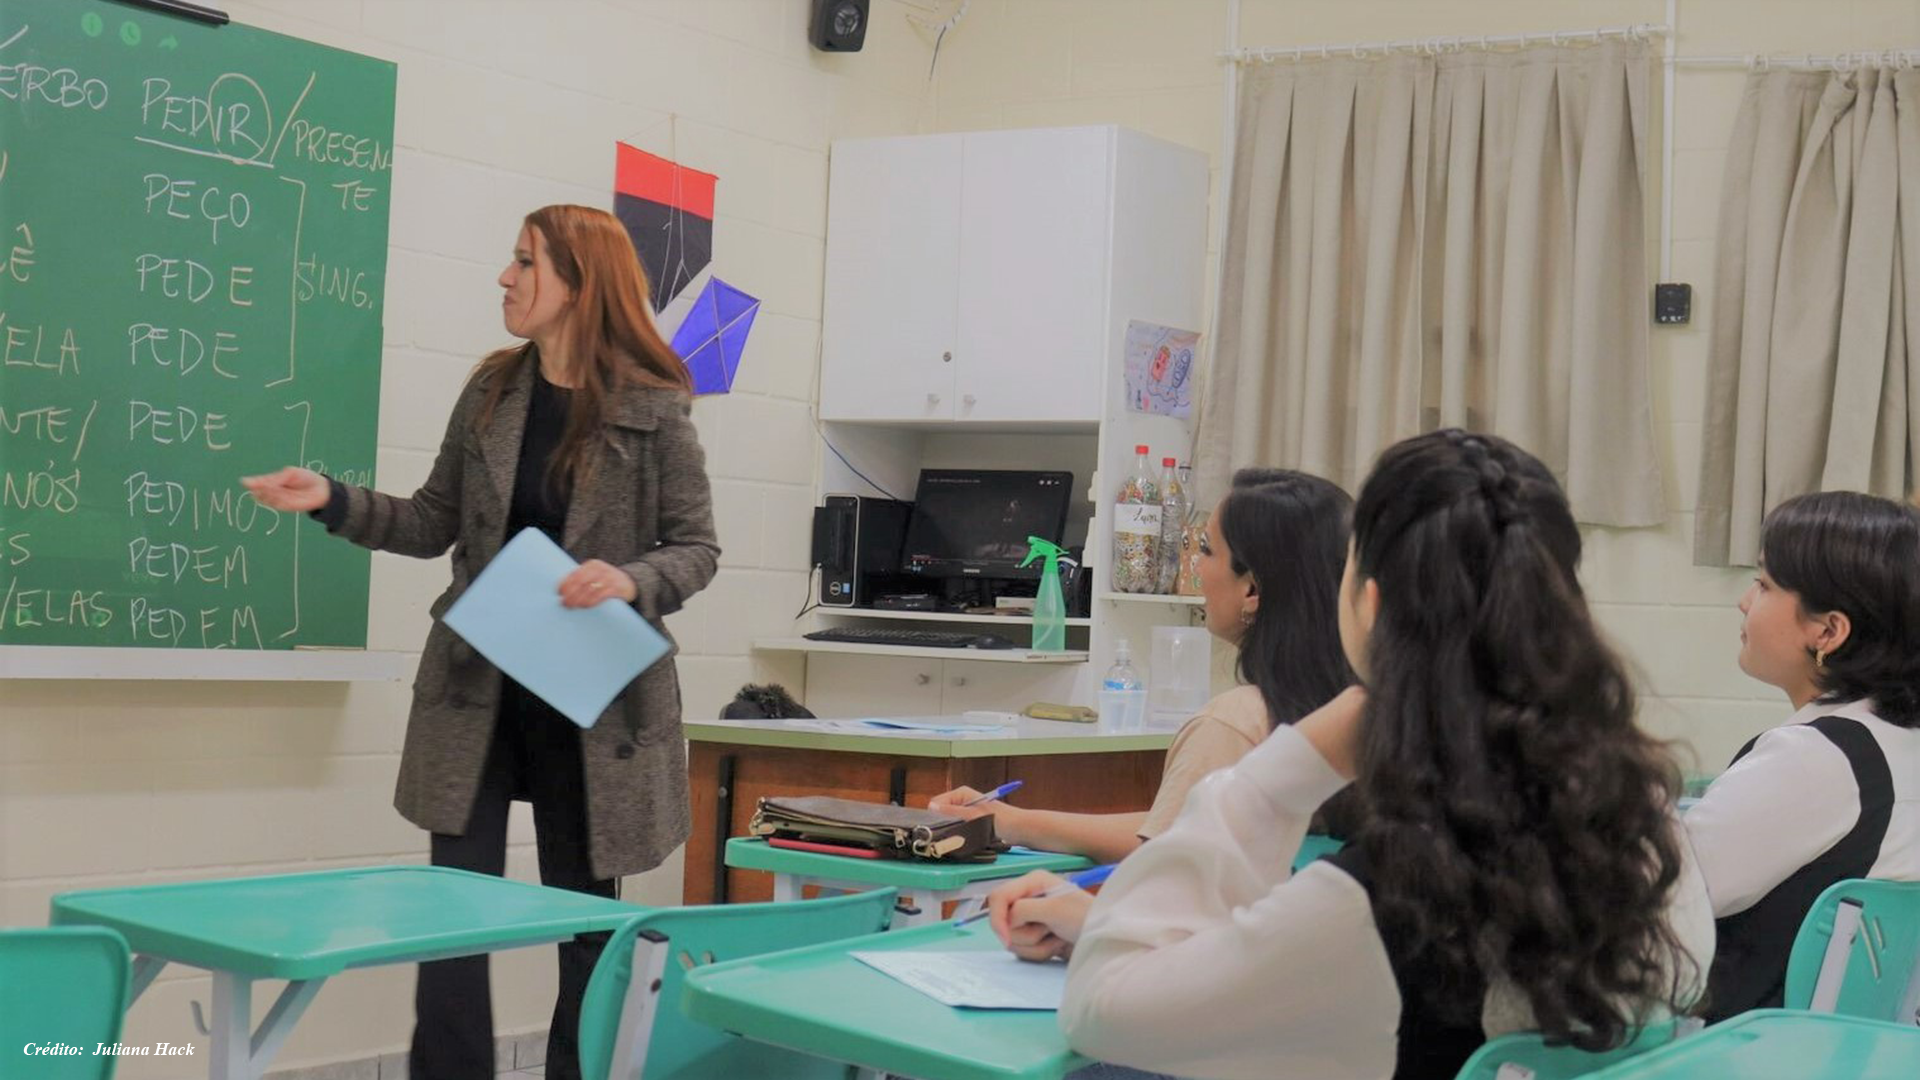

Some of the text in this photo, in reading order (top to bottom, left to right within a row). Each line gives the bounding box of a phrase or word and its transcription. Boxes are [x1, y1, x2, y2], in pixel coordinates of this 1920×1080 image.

[141, 77, 264, 153] PEDIR
[143, 173, 250, 245] PEÇO
[331, 179, 377, 211] TE
[135, 253, 254, 306] PEDE
[128, 322, 240, 379] PEDE
[129, 400, 232, 450] PEDE
[128, 536, 249, 589] PEDEM
